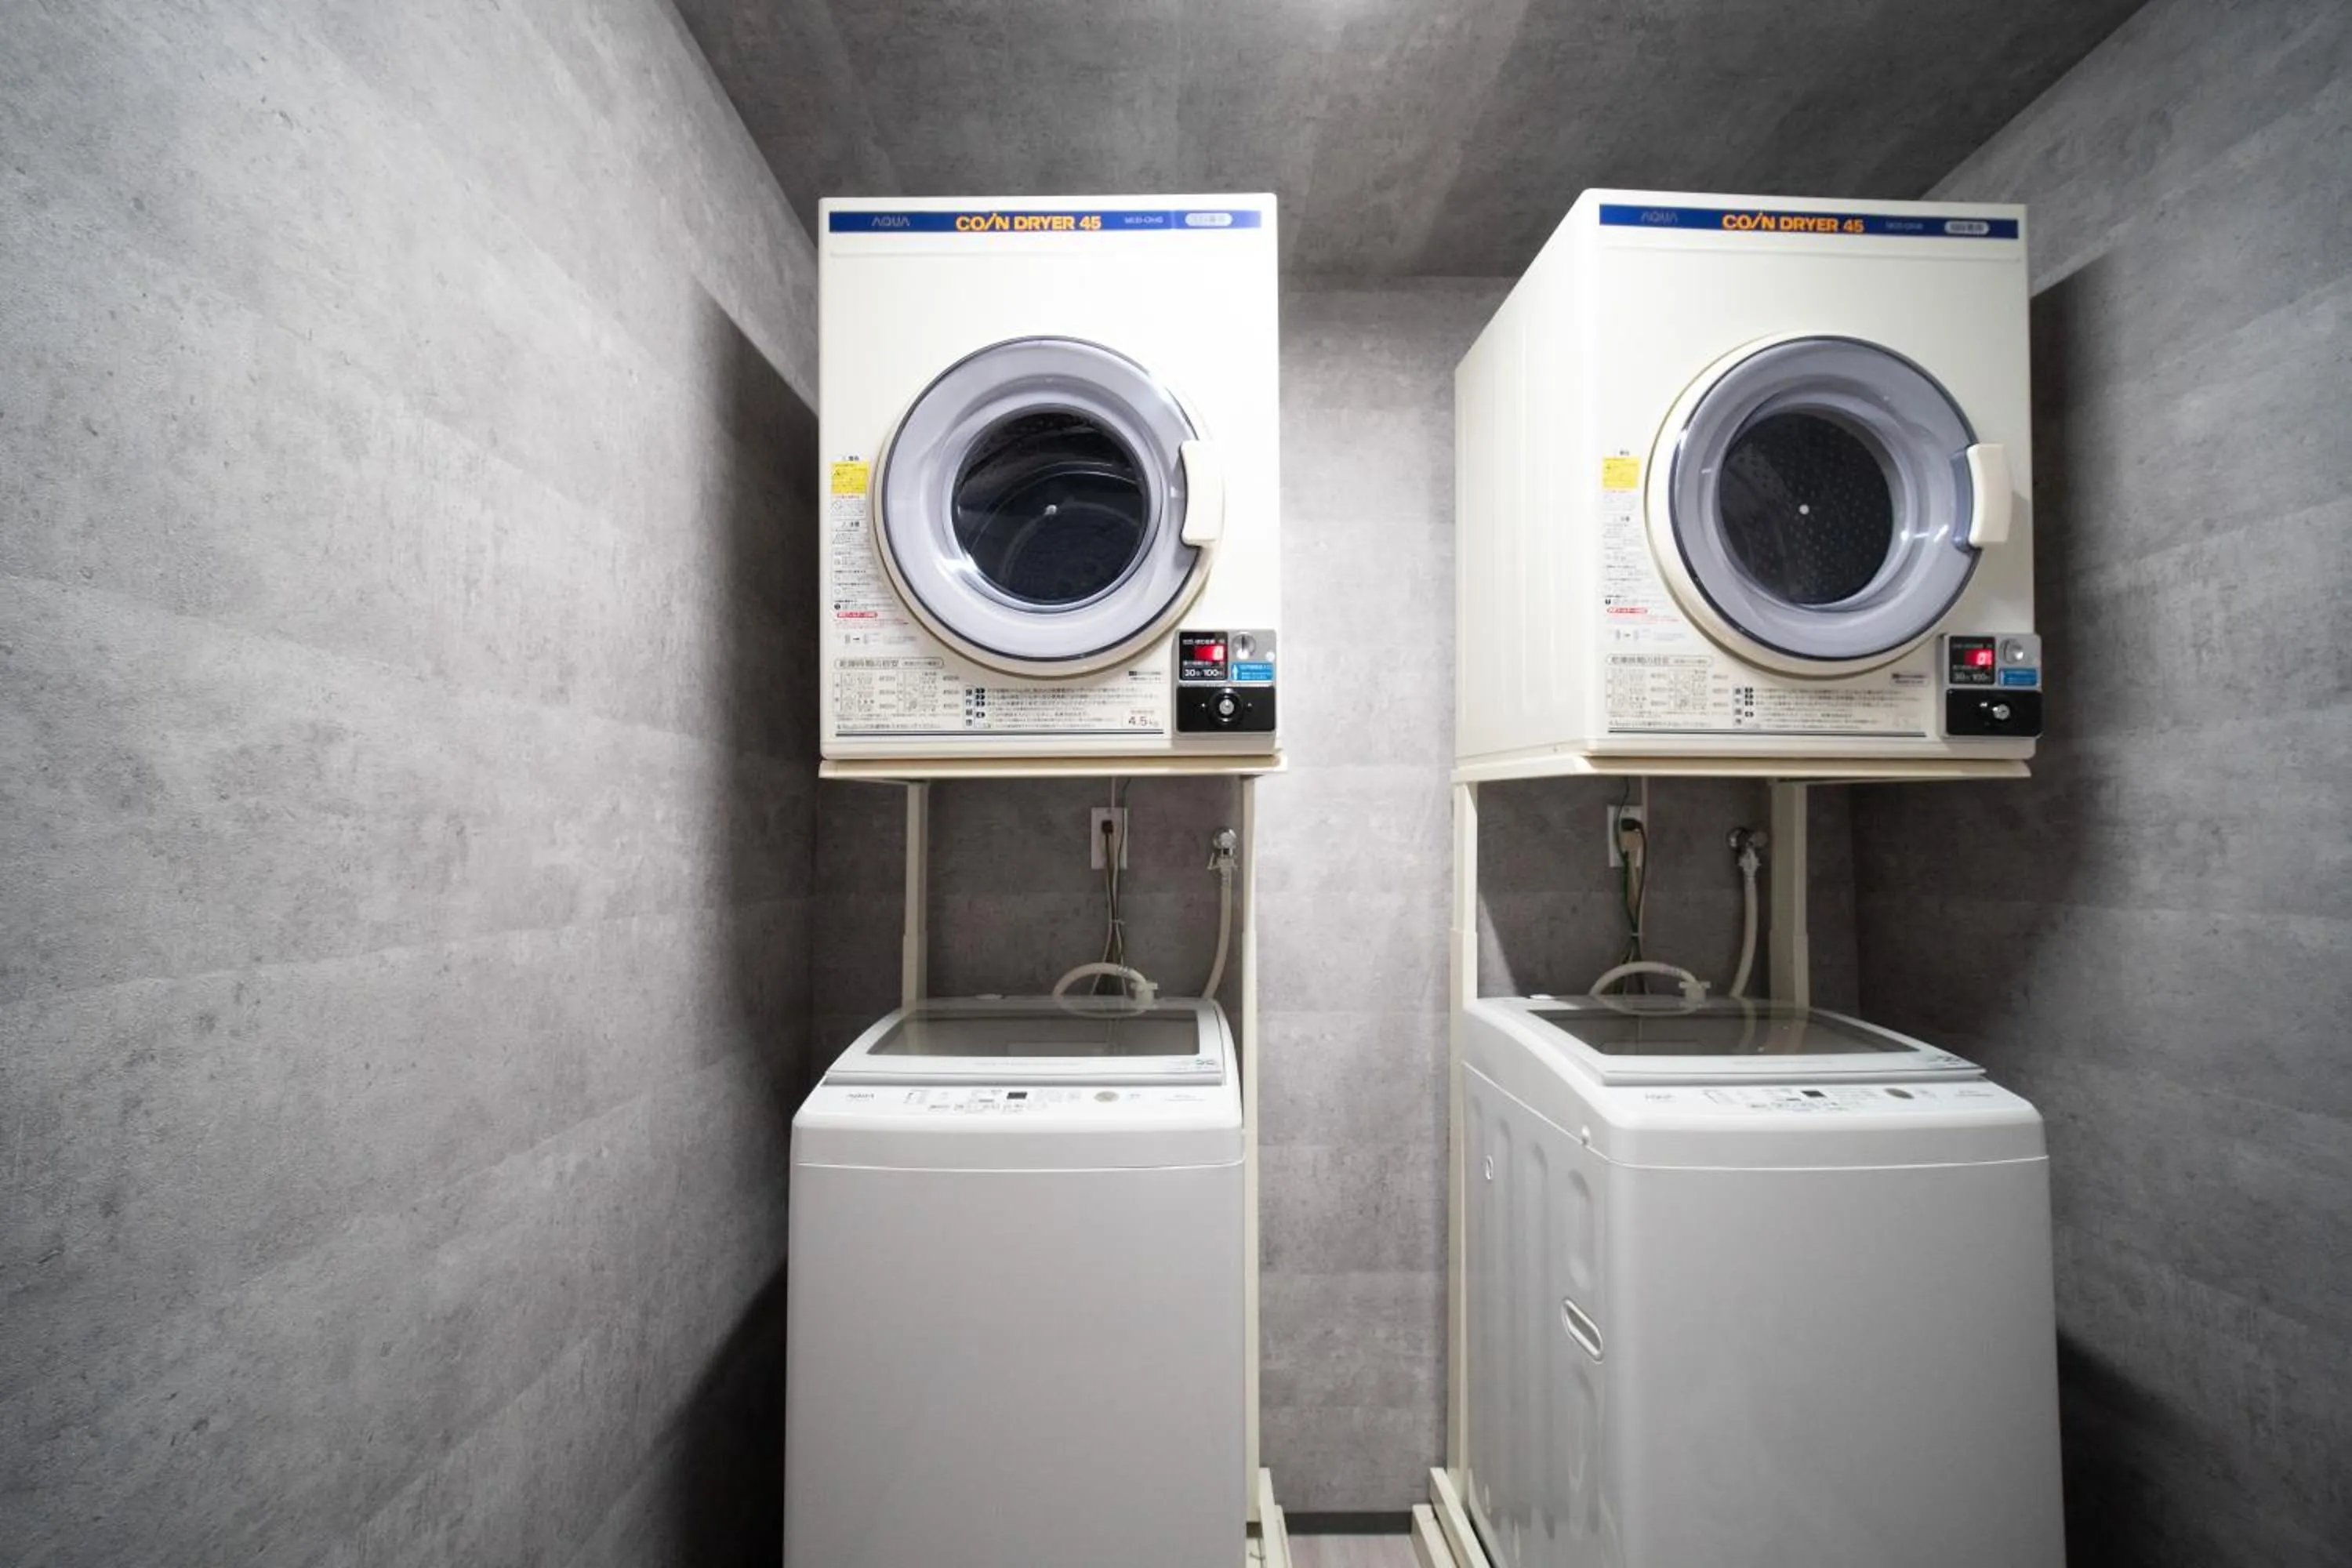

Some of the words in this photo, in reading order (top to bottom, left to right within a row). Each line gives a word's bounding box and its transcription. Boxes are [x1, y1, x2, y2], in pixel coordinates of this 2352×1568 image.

[871, 216, 910, 227] AQUA
[1014, 215, 1076, 230] DRYER
[1079, 215, 1102, 230] 45
[1779, 215, 1838, 233] DRYER
[1843, 218, 1864, 233] 45
